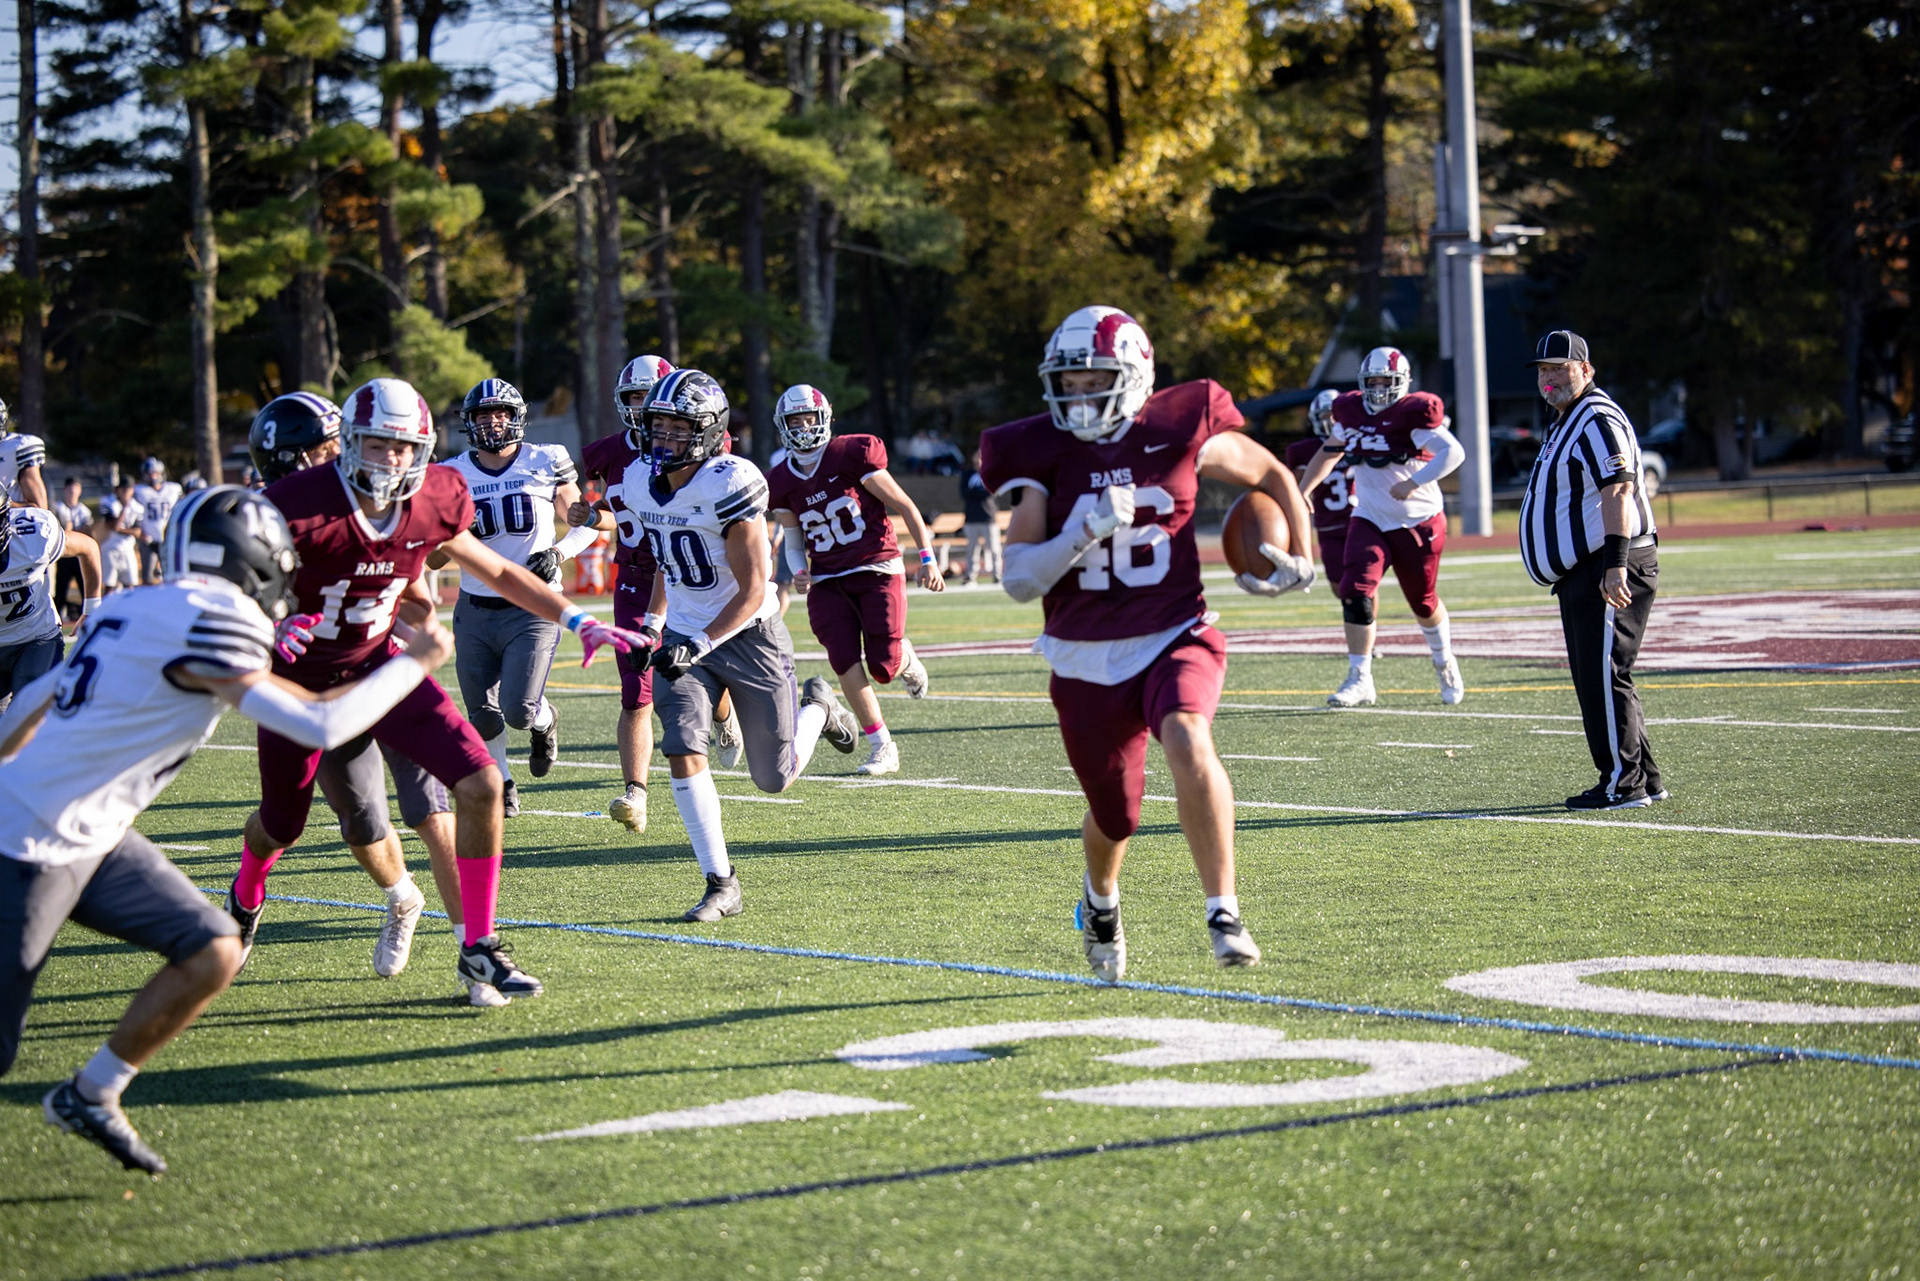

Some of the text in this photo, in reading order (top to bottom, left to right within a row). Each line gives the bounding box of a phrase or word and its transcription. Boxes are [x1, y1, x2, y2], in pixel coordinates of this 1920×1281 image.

[262, 420, 278, 450] 3
[472, 479, 525, 496] VALLEY TECH
[1090, 467, 1134, 488] RAMS
[806, 490, 828, 506] RAMS
[798, 495, 867, 553] 60
[353, 561, 396, 576] RAMS
[312, 577, 410, 641] 14
